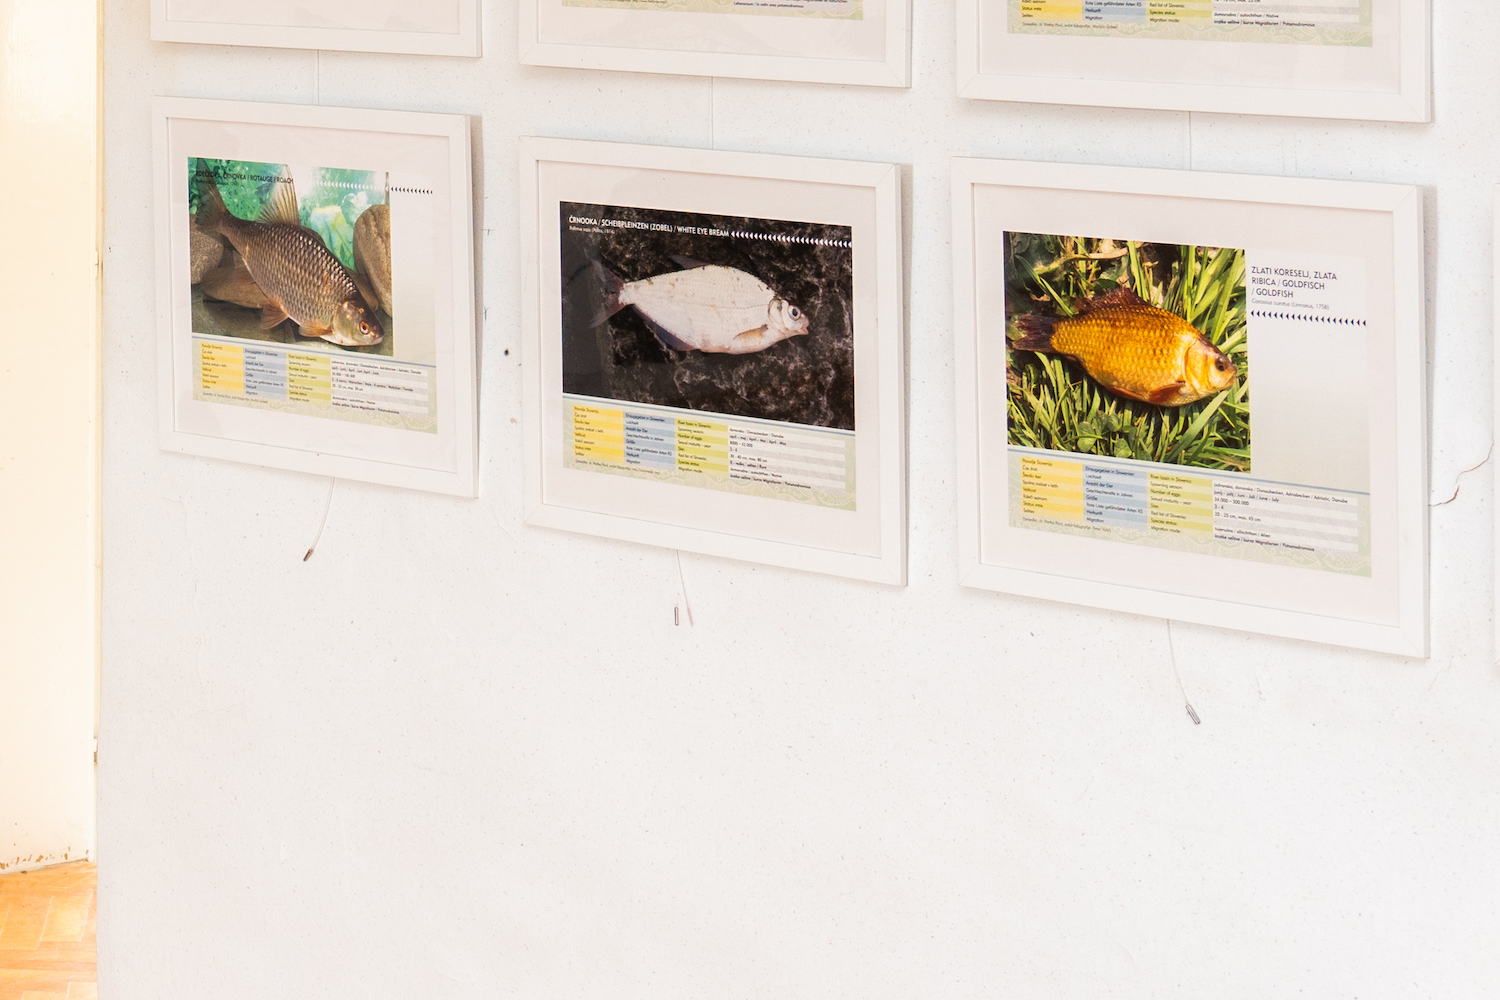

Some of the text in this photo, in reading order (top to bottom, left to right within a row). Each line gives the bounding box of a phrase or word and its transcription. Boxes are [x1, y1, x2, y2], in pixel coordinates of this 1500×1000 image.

[677, 226, 696, 234] WHITE
[709, 228, 729, 237] BREAM
[1252, 266, 1272, 274] ZLATI
[1314, 271, 1337, 280] ZLATA
[1252, 277, 1276, 286] RIBICA
[1282, 280, 1325, 290] GOLDFISCH
[1256, 288, 1294, 298] GOLDFISH
